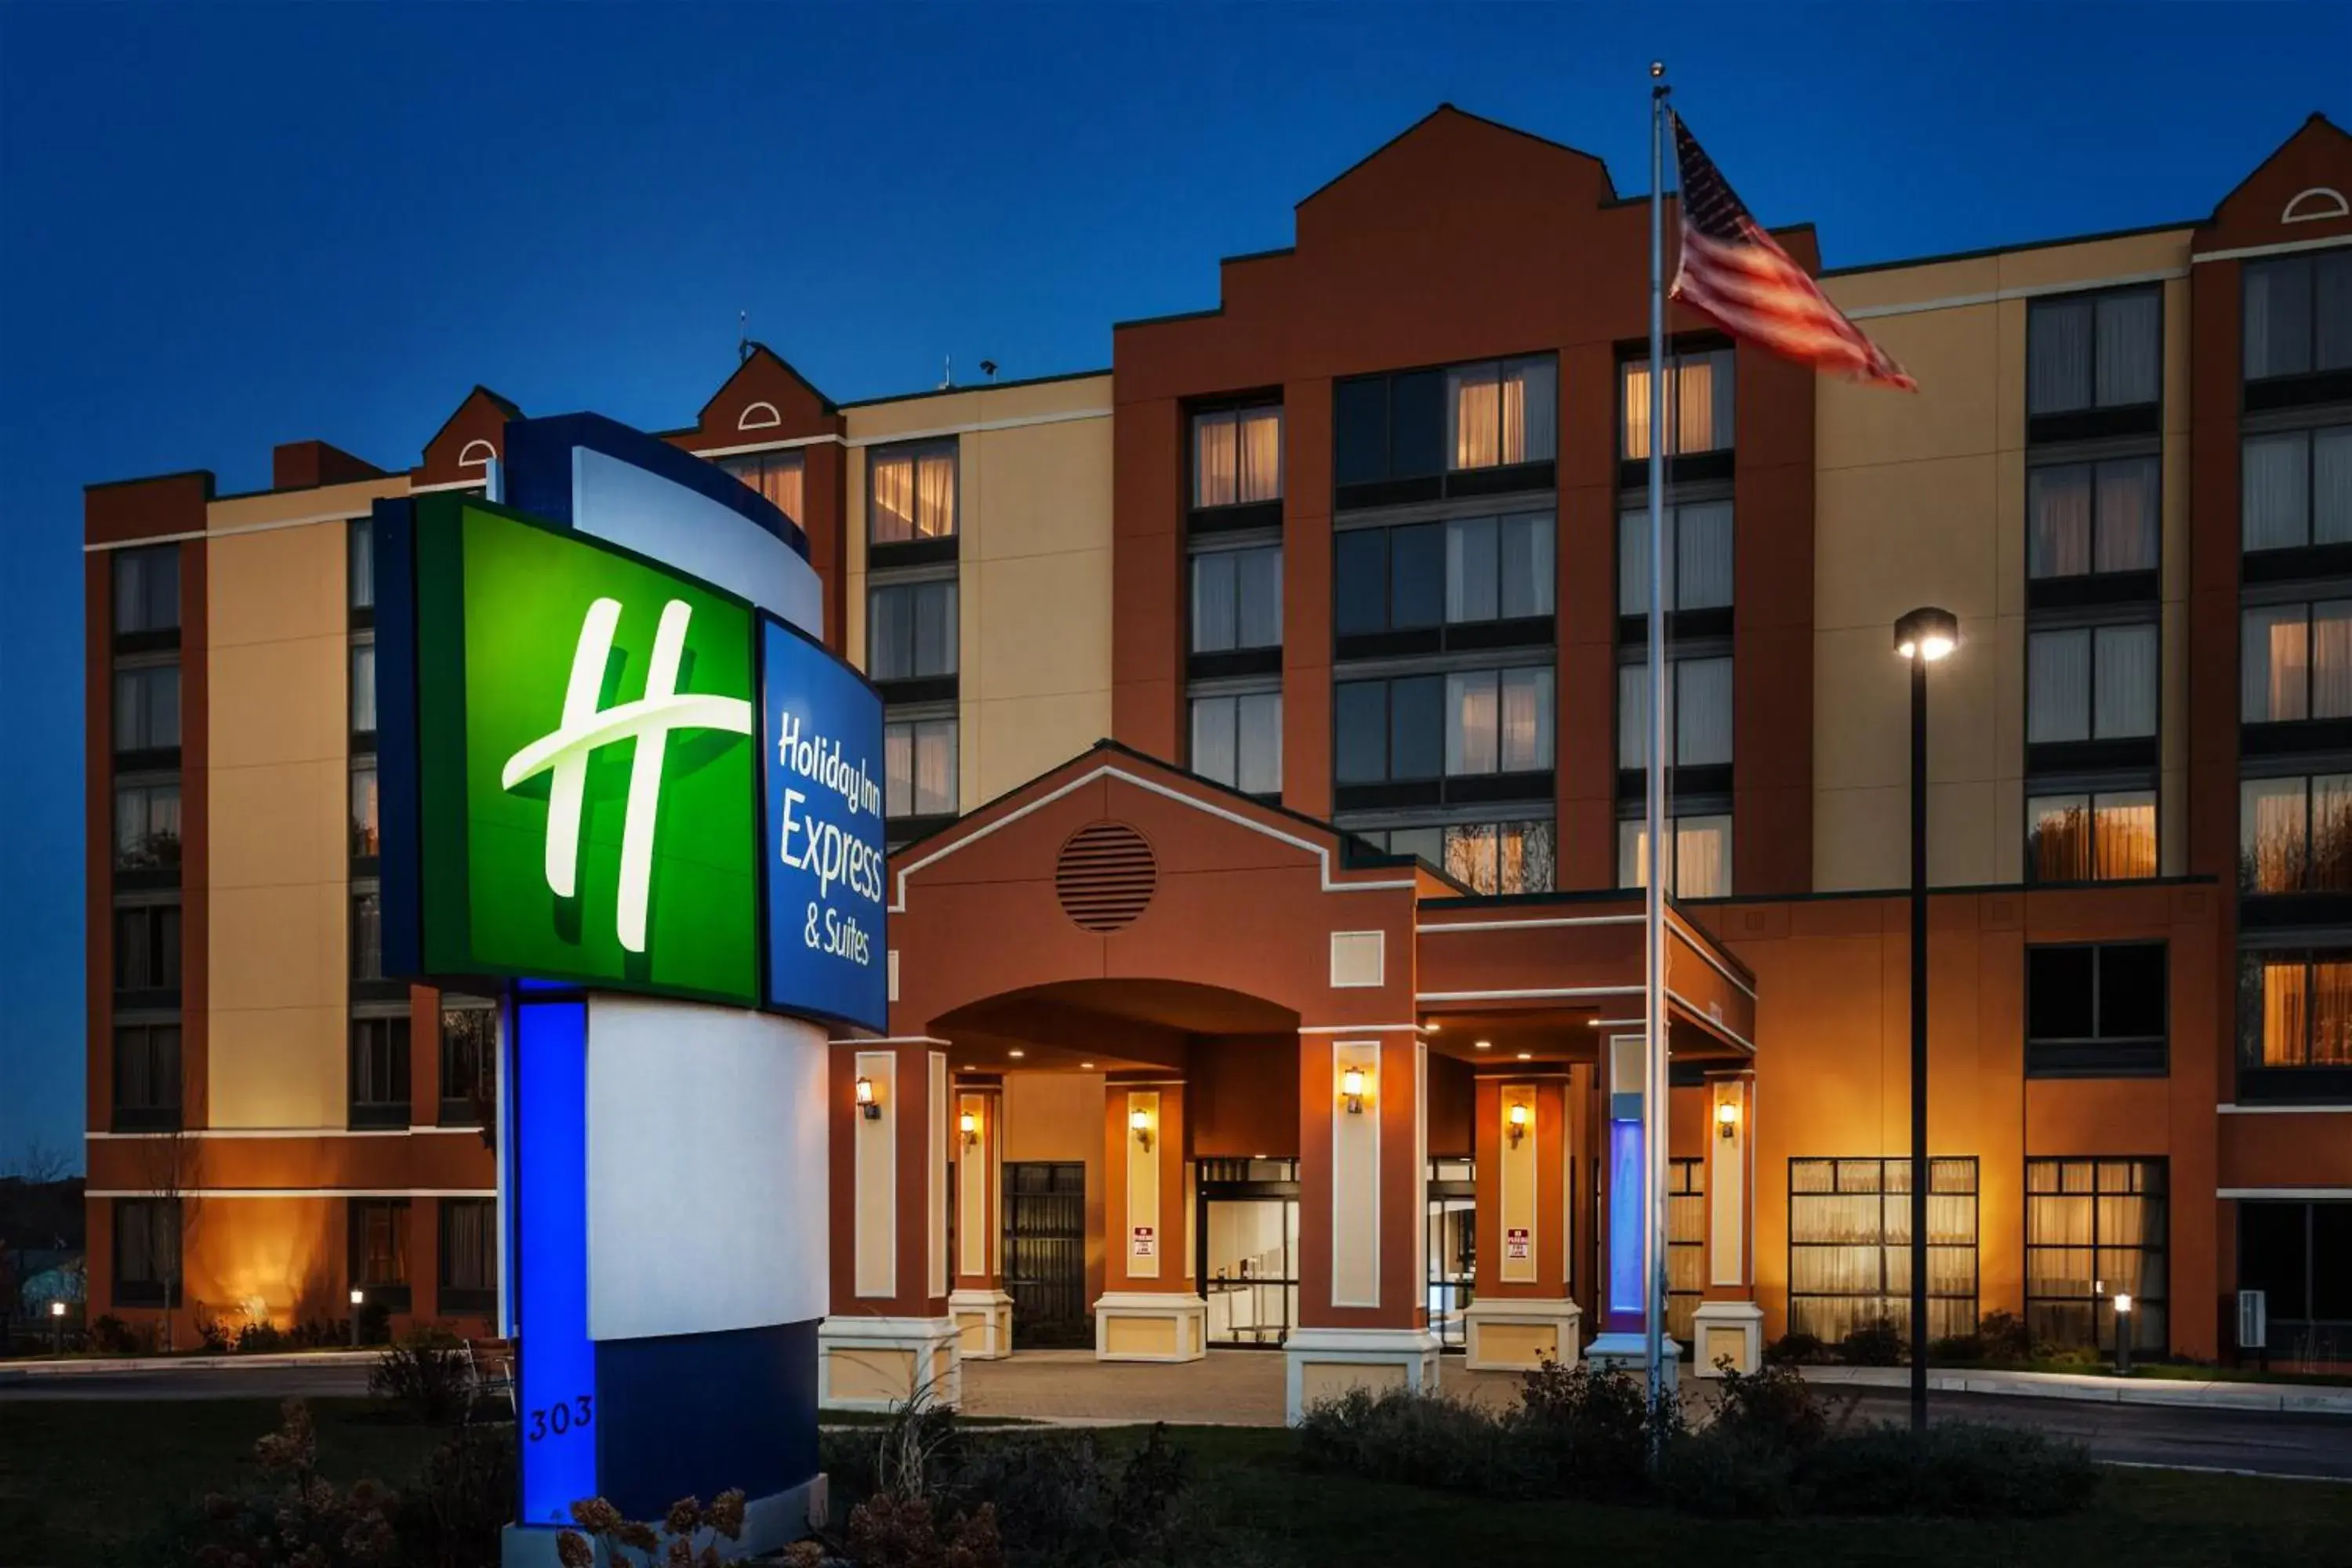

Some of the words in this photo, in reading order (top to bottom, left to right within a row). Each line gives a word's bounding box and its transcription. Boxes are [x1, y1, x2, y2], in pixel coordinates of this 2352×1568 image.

[502, 597, 752, 953] H
[779, 711, 859, 814] Holiday
[781, 788, 881, 902] Express
[804, 902, 820, 948] &
[824, 908, 869, 966] Suites
[529, 1396, 592, 1442] 303
